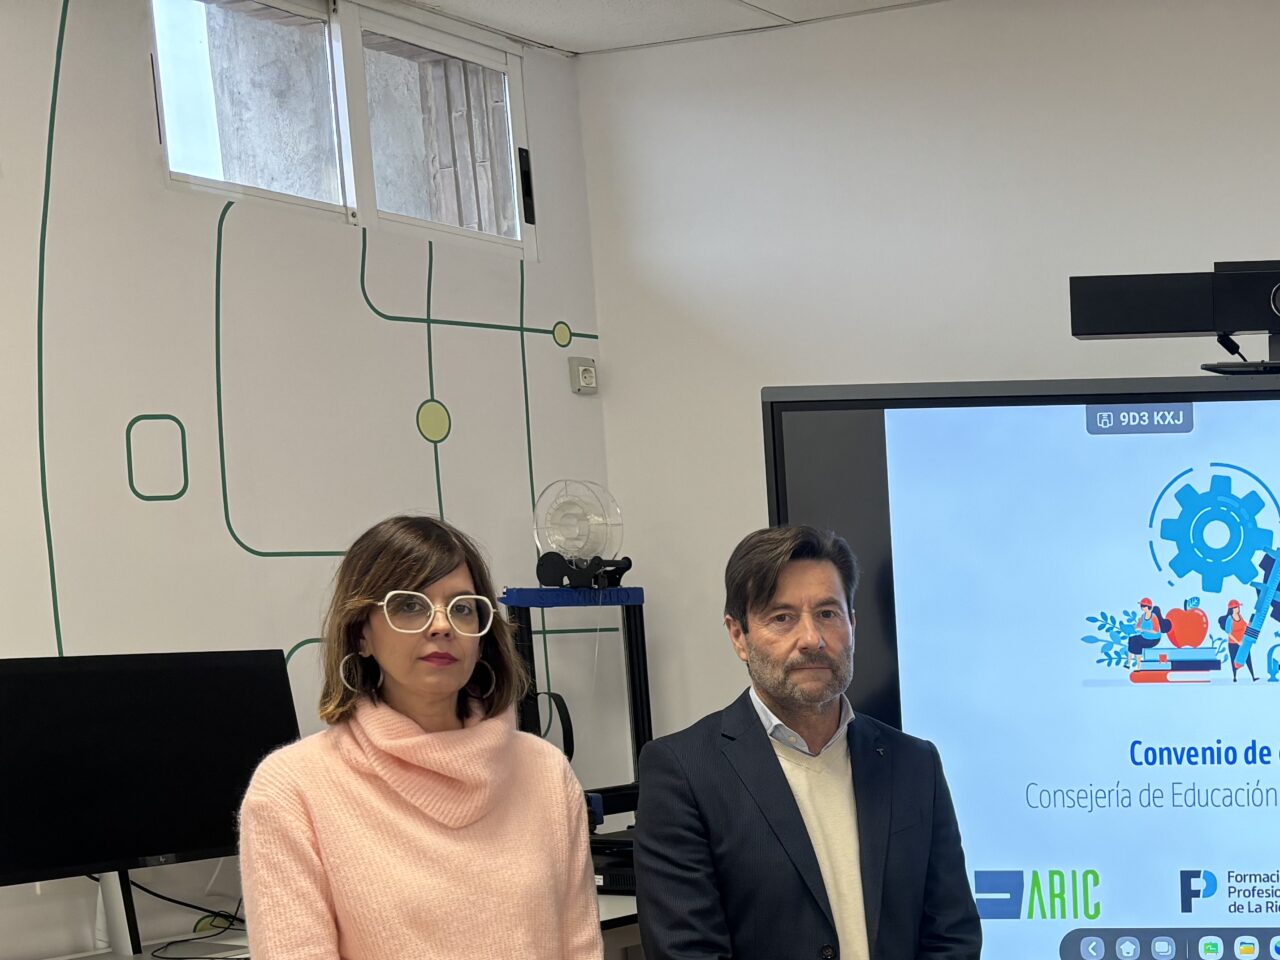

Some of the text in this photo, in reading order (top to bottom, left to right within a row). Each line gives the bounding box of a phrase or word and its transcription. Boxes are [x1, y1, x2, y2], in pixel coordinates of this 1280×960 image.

[1120, 411, 1184, 426] 9D3 KXJ
[1130, 739, 1238, 766] Convenio
[1243, 739, 1272, 765] de
[1025, 781, 1132, 813] Consejería
[1139, 782, 1164, 807] de
[1172, 780, 1278, 808] Educación
[1027, 869, 1101, 920] ARIC
[1228, 901, 1245, 913] de
[1248, 901, 1263, 913] La
